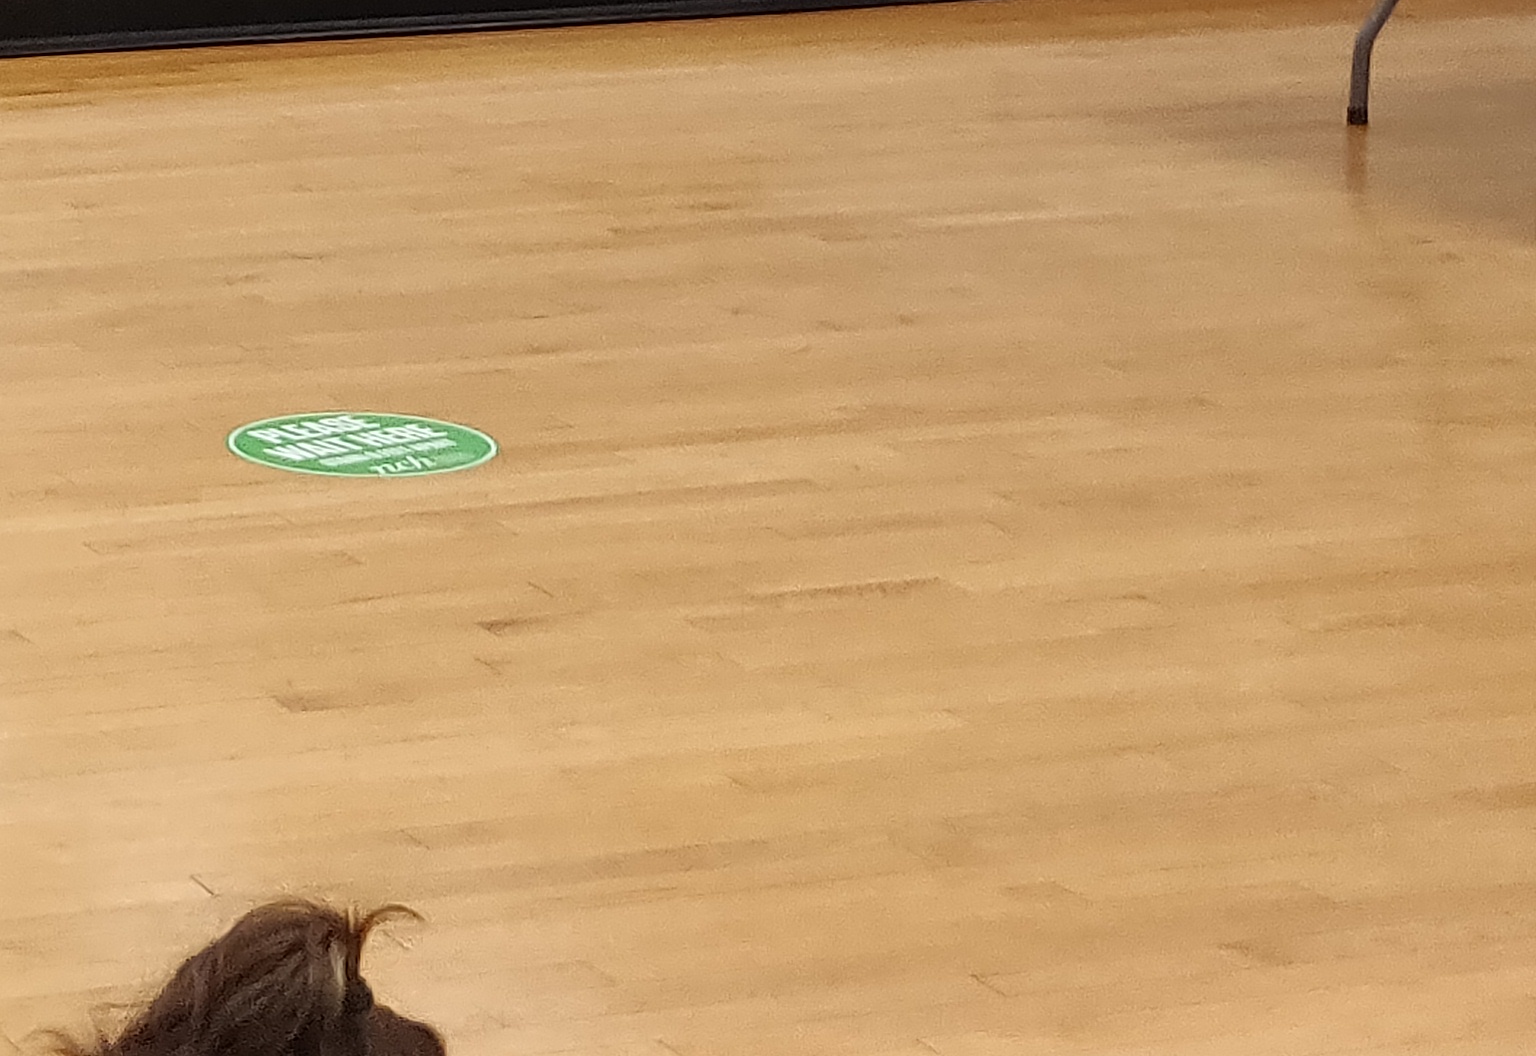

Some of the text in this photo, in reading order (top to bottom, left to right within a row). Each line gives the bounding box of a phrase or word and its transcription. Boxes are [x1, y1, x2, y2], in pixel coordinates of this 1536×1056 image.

[247, 415, 380, 444] PLEASE
[263, 437, 362, 461] WAIT
[347, 424, 447, 447] HERE
